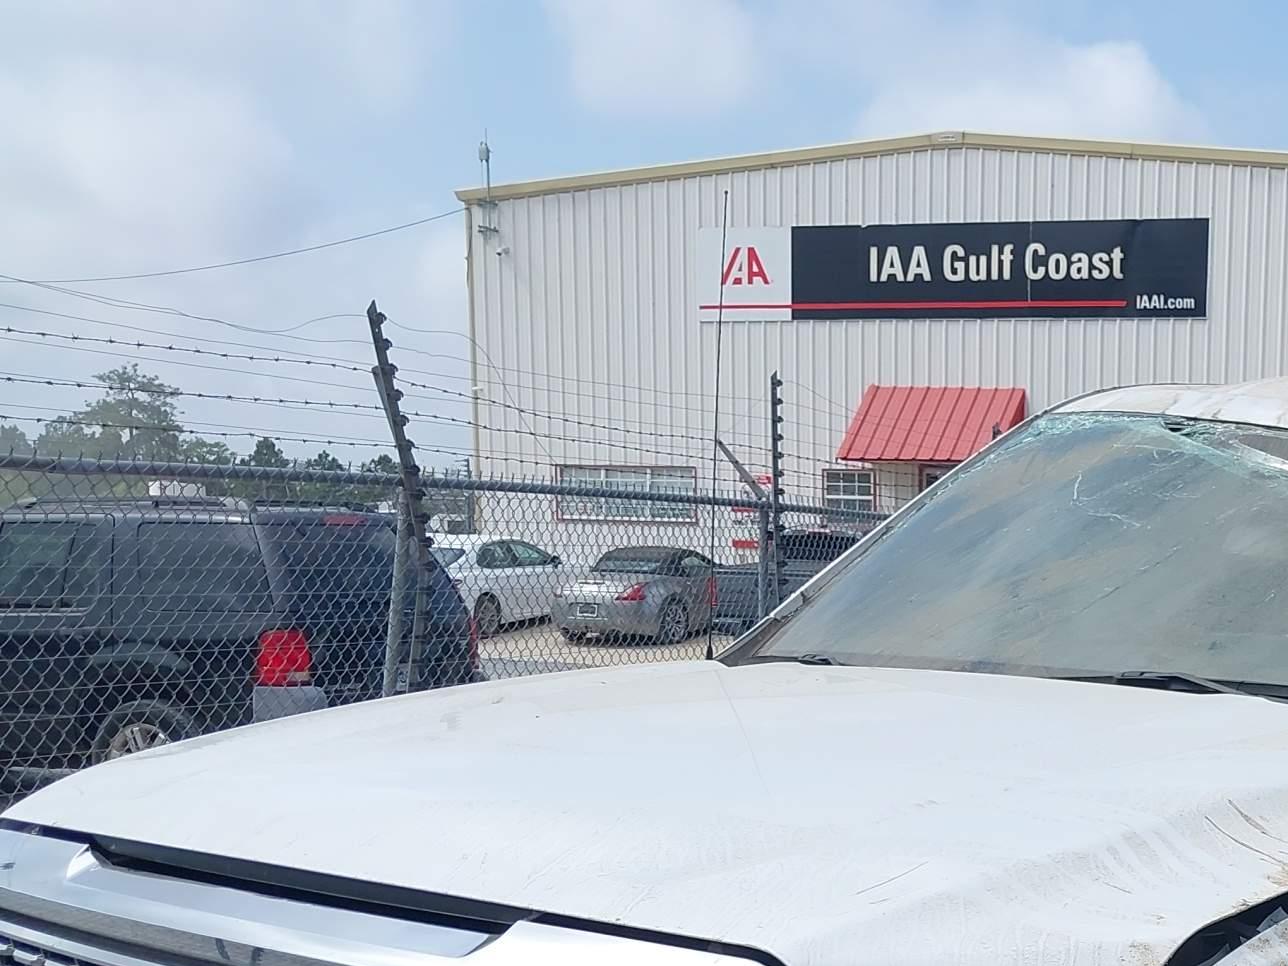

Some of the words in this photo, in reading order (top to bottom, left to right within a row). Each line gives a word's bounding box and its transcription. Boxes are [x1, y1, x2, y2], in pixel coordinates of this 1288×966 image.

[869, 245, 932, 282] IAA
[943, 243, 1014, 282] Gulf
[1025, 242, 1124, 281] Coast
[1136, 294, 1195, 309] IAAI.com
